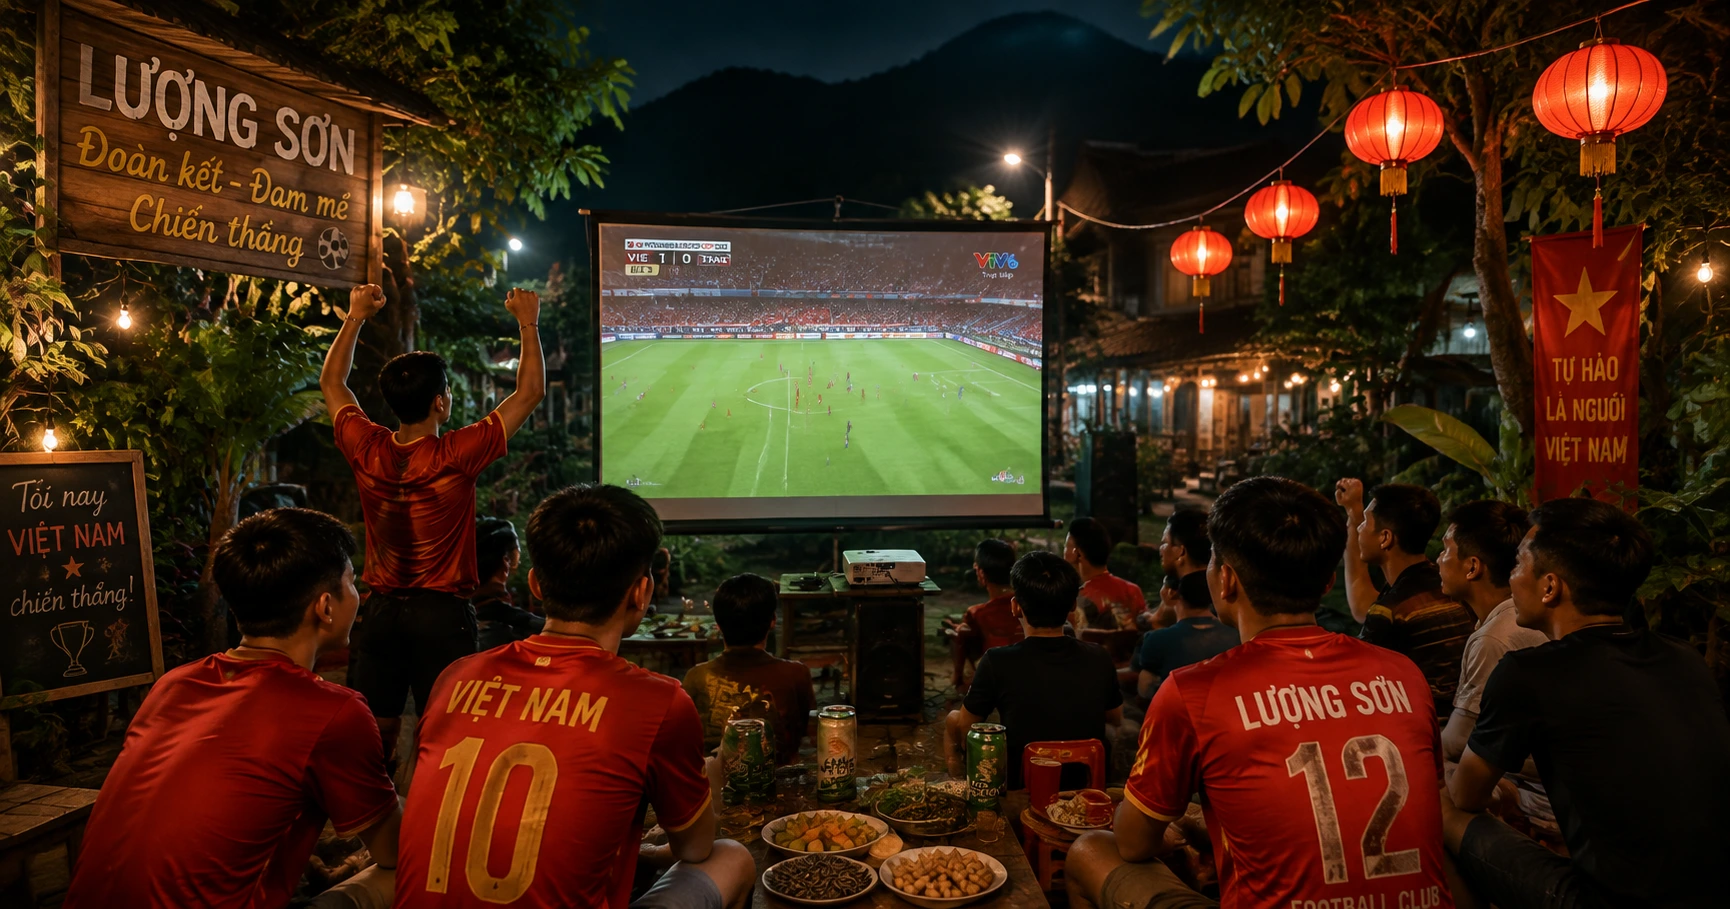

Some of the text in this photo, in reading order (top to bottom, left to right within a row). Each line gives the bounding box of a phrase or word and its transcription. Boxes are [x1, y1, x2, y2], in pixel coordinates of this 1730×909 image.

[78, 43, 355, 175] LƯỢNG SƠN
[77, 125, 169, 182] Đoàn
[178, 150, 224, 194] kết
[249, 167, 309, 213] Đam
[129, 193, 219, 244] Chiến
[682, 253, 691, 264] 0
[1552, 355, 1575, 385] TỰ
[1588, 434, 1628, 464] NAM
[62, 489, 108, 517] nay
[7, 520, 125, 559] VIỆT NAM
[446, 675, 608, 733] VIỆT NAM
[1235, 684, 1347, 731] LƯỢNG
[425, 736, 558, 905] 10
[1285, 734, 1421, 885] 12
[1399, 886, 1440, 909] CLUB
